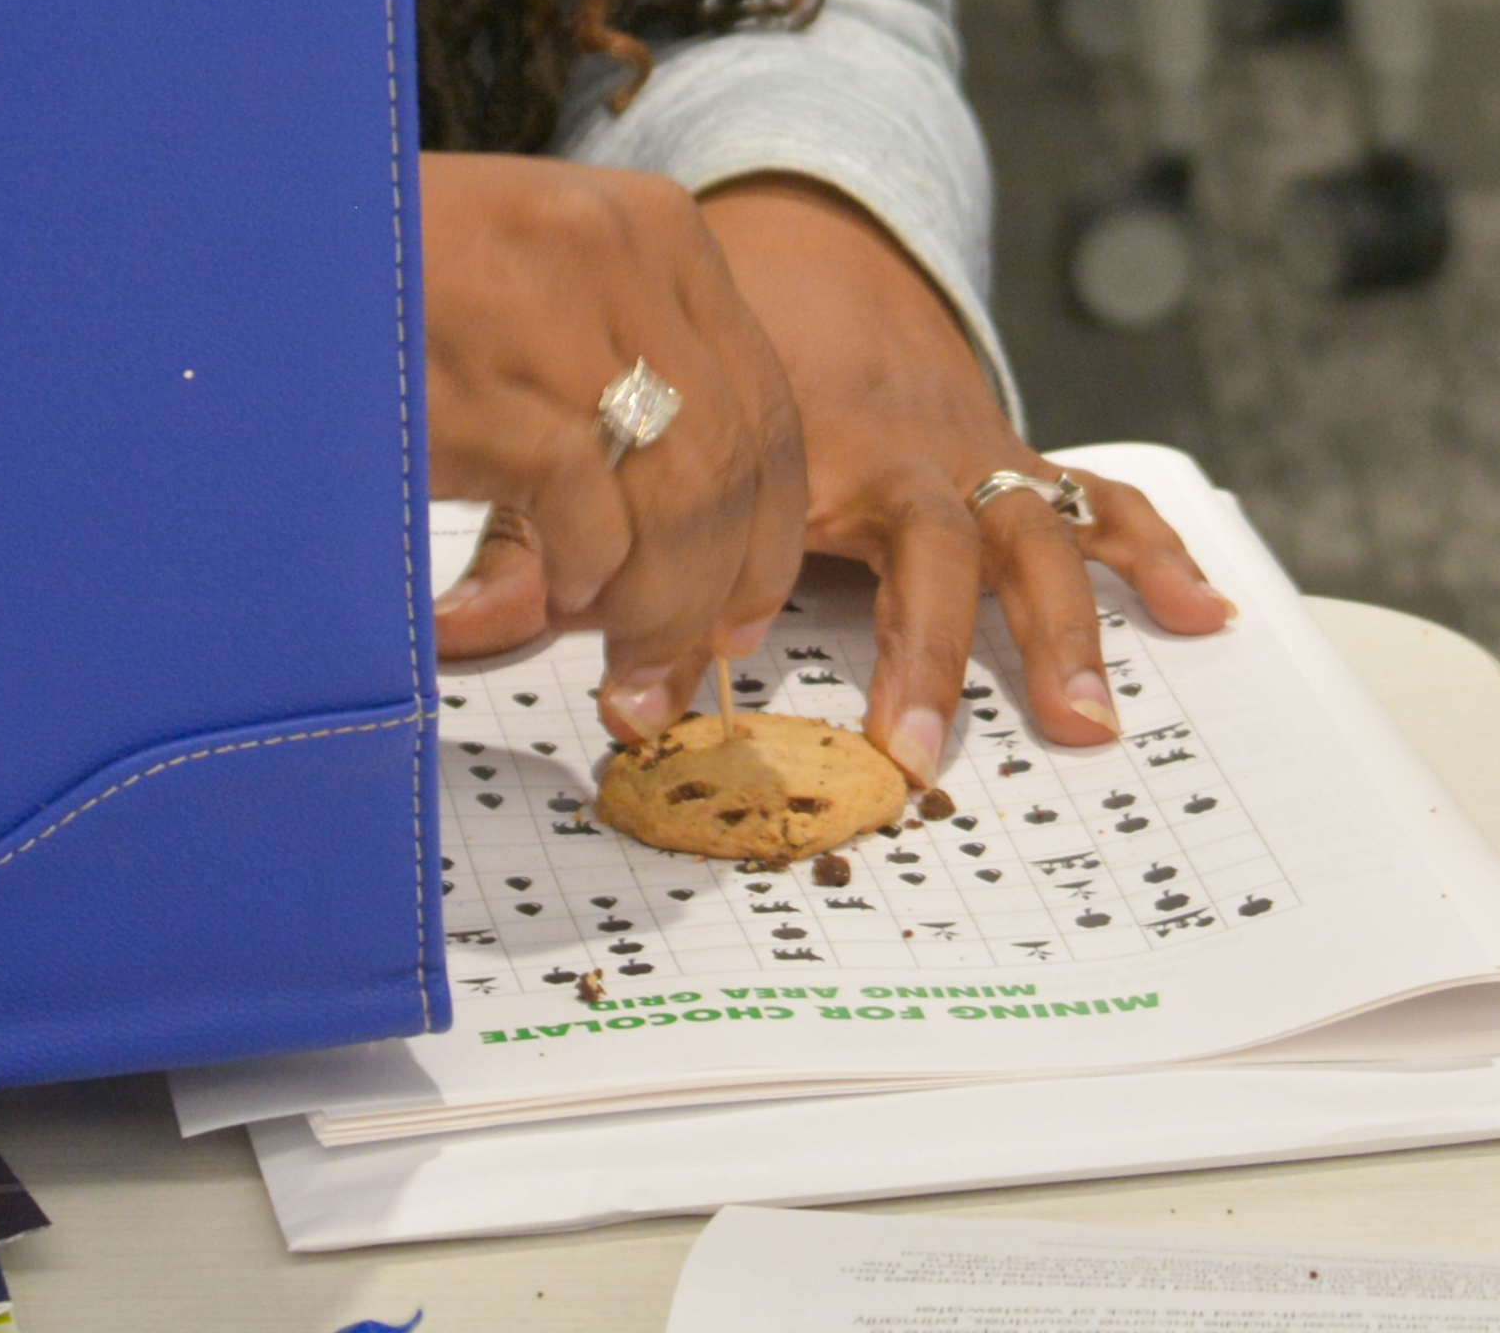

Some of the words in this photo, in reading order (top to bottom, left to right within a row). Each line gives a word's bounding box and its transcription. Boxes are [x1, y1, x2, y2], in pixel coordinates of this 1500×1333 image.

[721, 986, 840, 1001] AREA
[862, 984, 1038, 1000] MINING
[588, 989, 703, 1012] GRID
[947, 992, 1163, 1021] MINING
[820, 1004, 926, 1022] FOR
[482, 1005, 796, 1045] CHOCOLATE
[914, 1306, 1065, 1316] wastewater
[1105, 1308, 1158, 1317] lack
[1214, 1310, 1266, 1319] and
